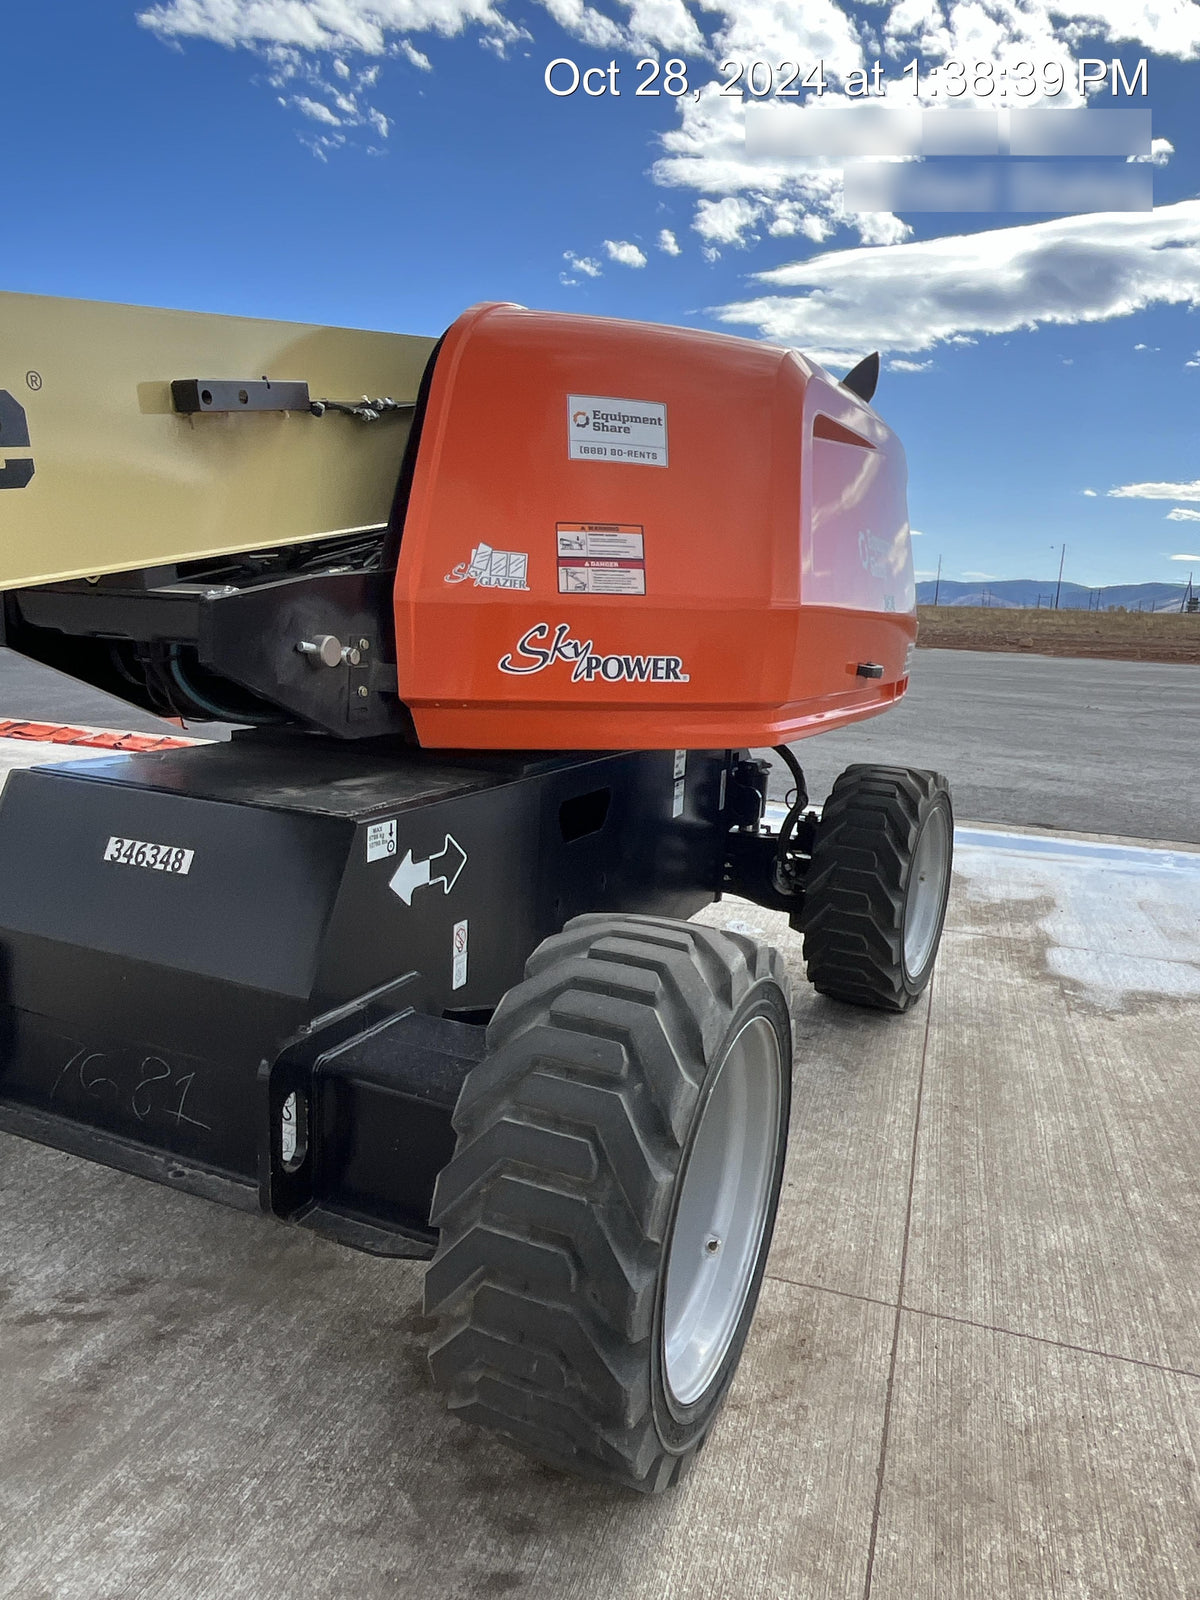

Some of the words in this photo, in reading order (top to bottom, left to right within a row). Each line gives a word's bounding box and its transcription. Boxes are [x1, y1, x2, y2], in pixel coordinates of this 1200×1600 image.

[592, 409, 663, 427] Equipment
[592, 421, 631, 434] Share
[110, 838, 186, 873] 346348
